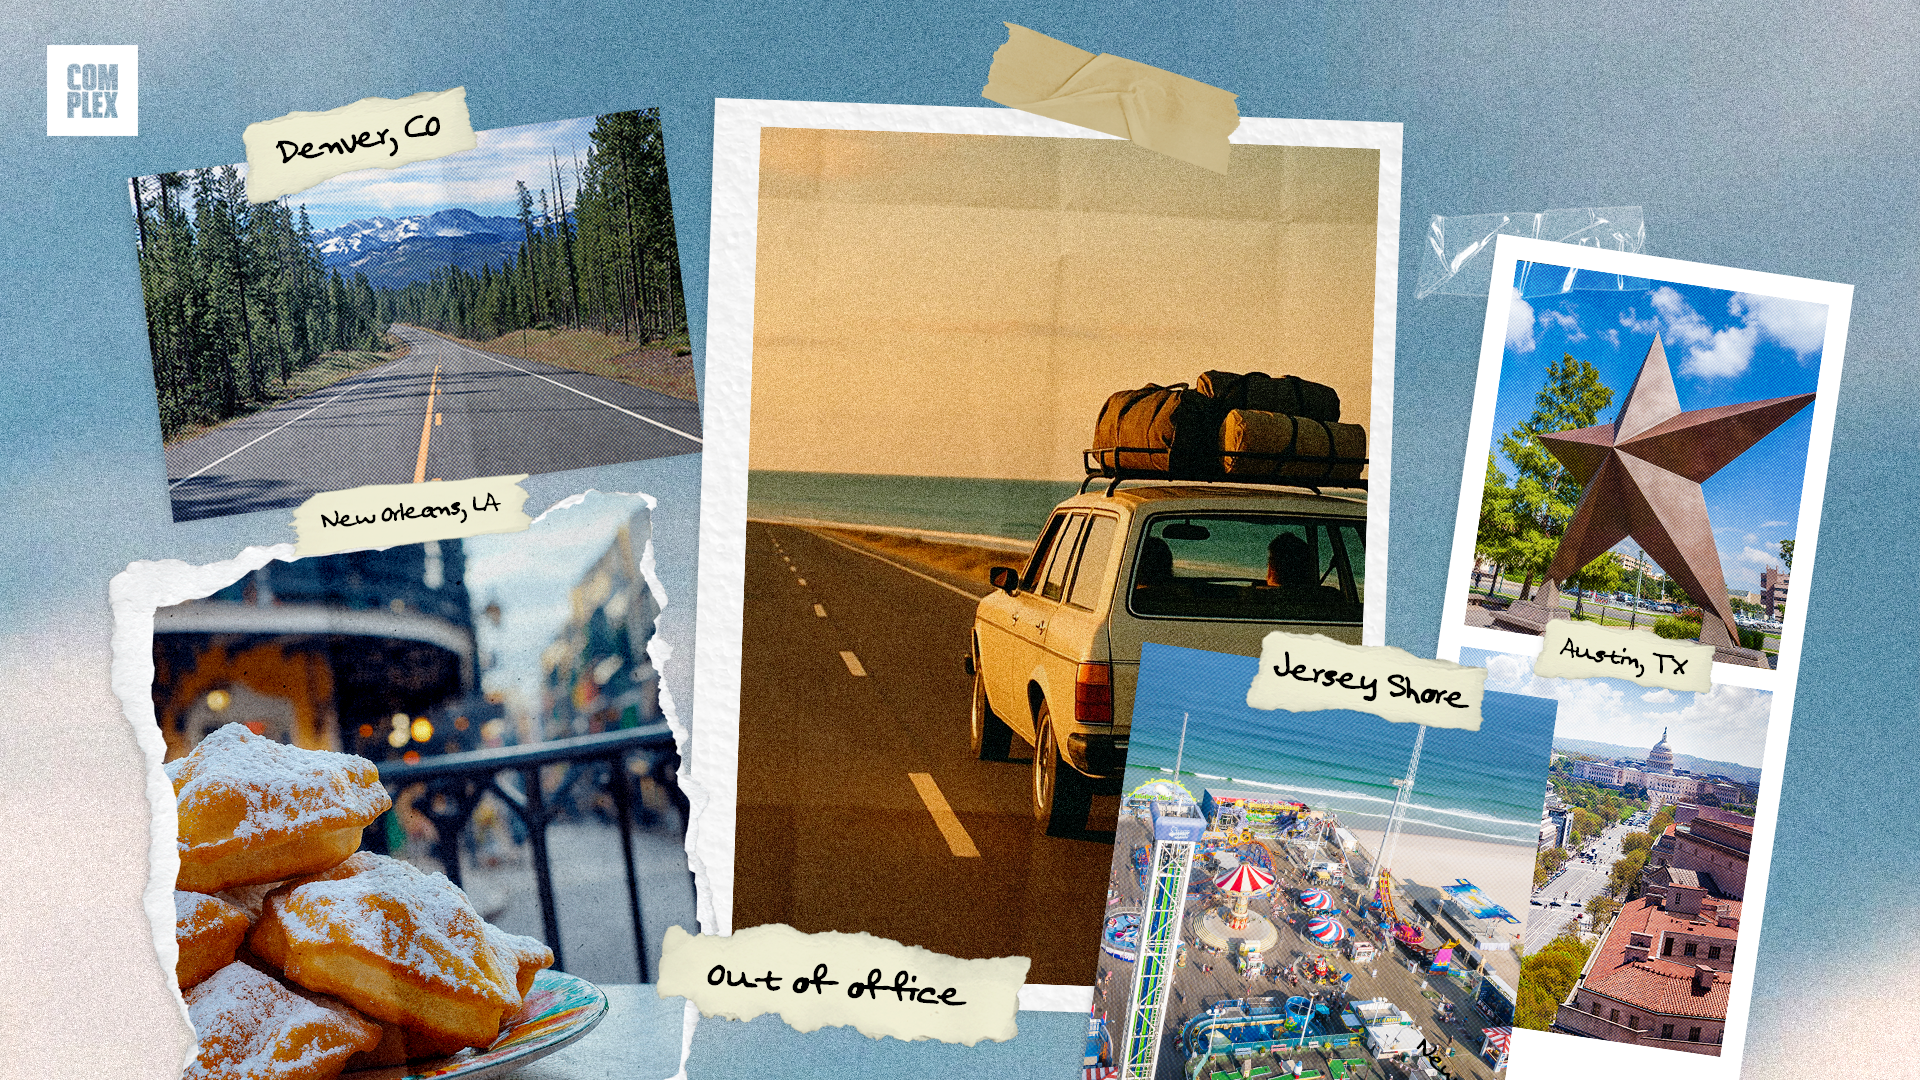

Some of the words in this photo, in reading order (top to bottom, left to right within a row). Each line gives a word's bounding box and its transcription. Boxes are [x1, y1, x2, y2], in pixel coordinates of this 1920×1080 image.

[275, 128, 398, 163] Denver,
[320, 510, 376, 528] New
[381, 501, 468, 524] Orleans,
[472, 492, 502, 512] LA
[1559, 637, 1645, 678] Austin,
[1652, 652, 1689, 675] TX
[1273, 651, 1378, 702] Jersey
[1387, 674, 1470, 708] Shore
[792, 963, 839, 995] of
[847, 968, 967, 1006] office
